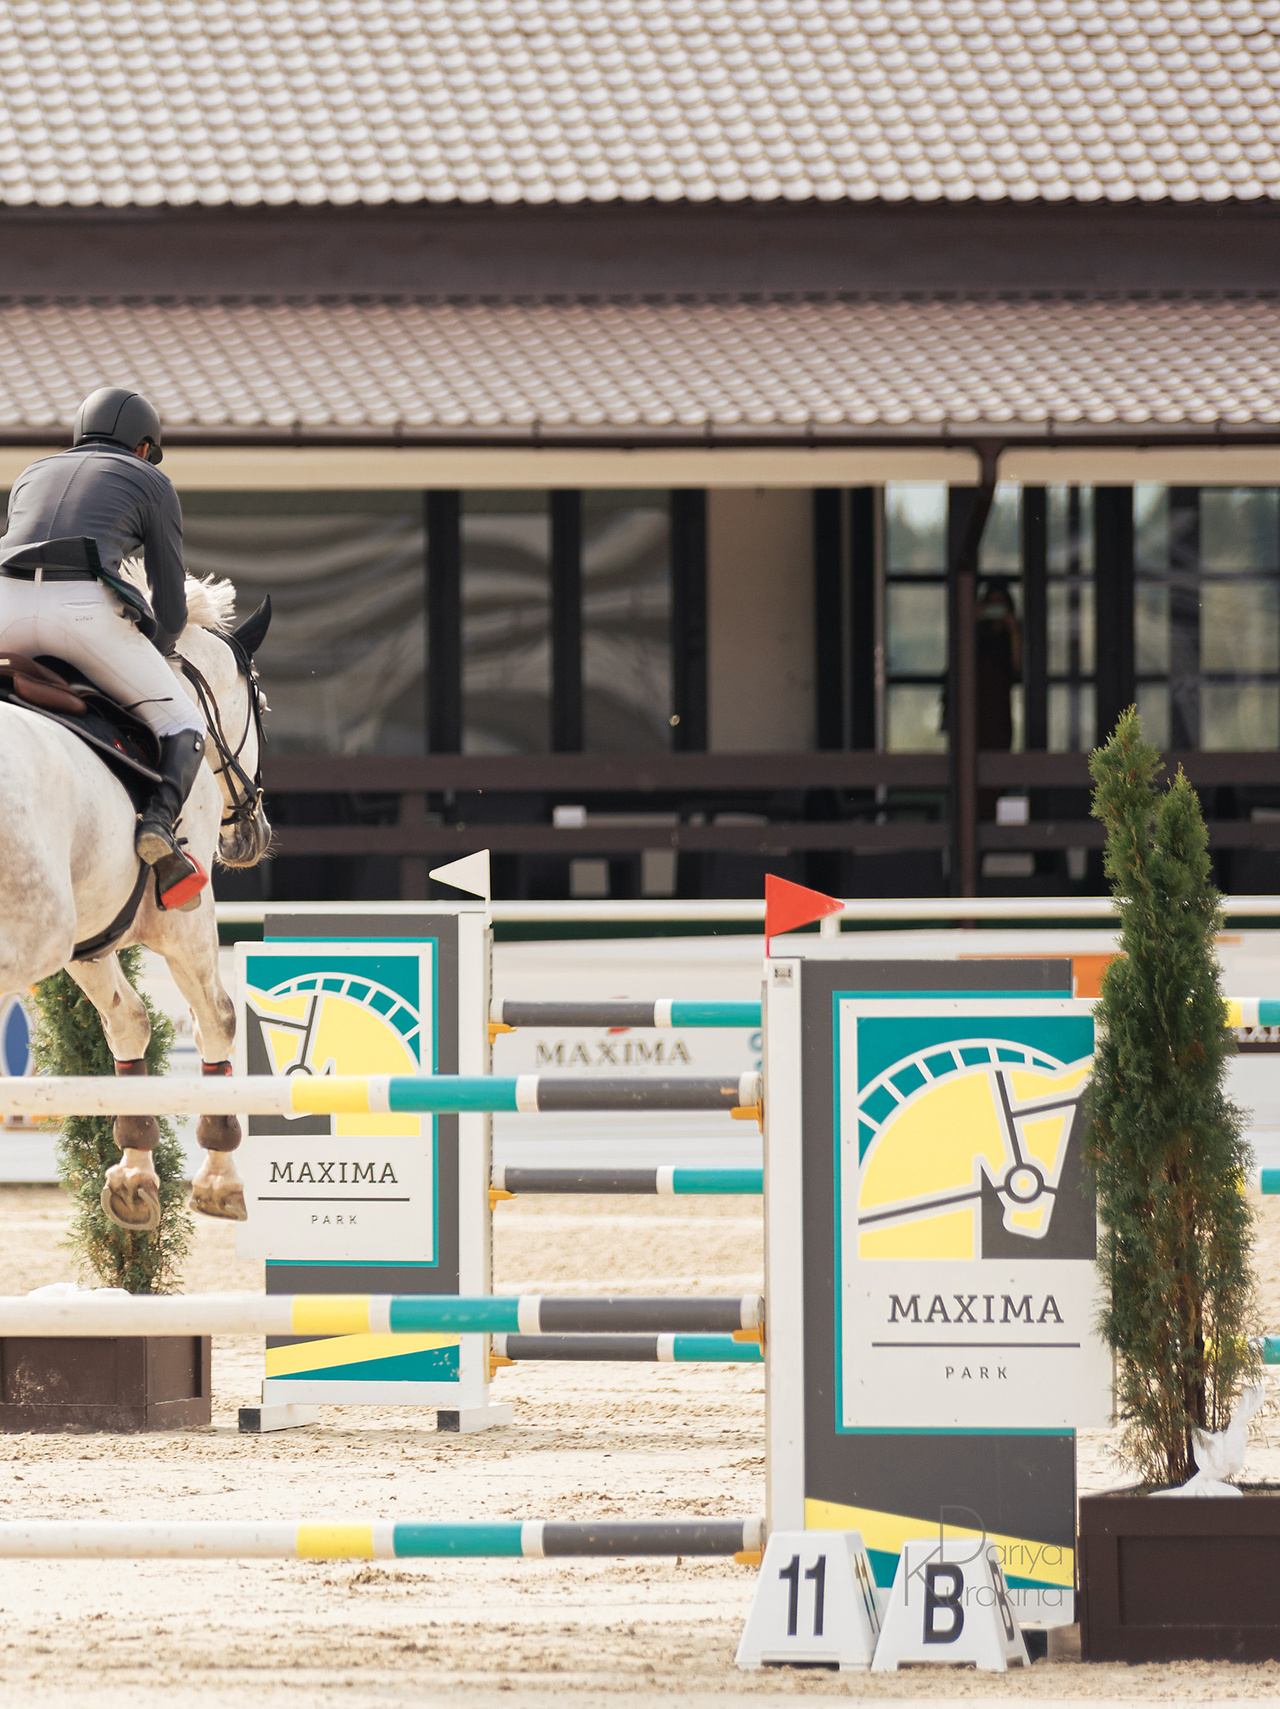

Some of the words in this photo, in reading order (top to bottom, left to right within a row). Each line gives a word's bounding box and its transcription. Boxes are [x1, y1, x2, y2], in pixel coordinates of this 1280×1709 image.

[535, 1039, 692, 1066] MAXIMA
[269, 1161, 399, 1184] MAXIMA
[311, 1215, 358, 1225] PARK
[887, 1294, 1065, 1324] MAXIMA
[945, 1366, 1008, 1379] PARK
[779, 1554, 826, 1636] 11
[922, 1563, 965, 1644] B
